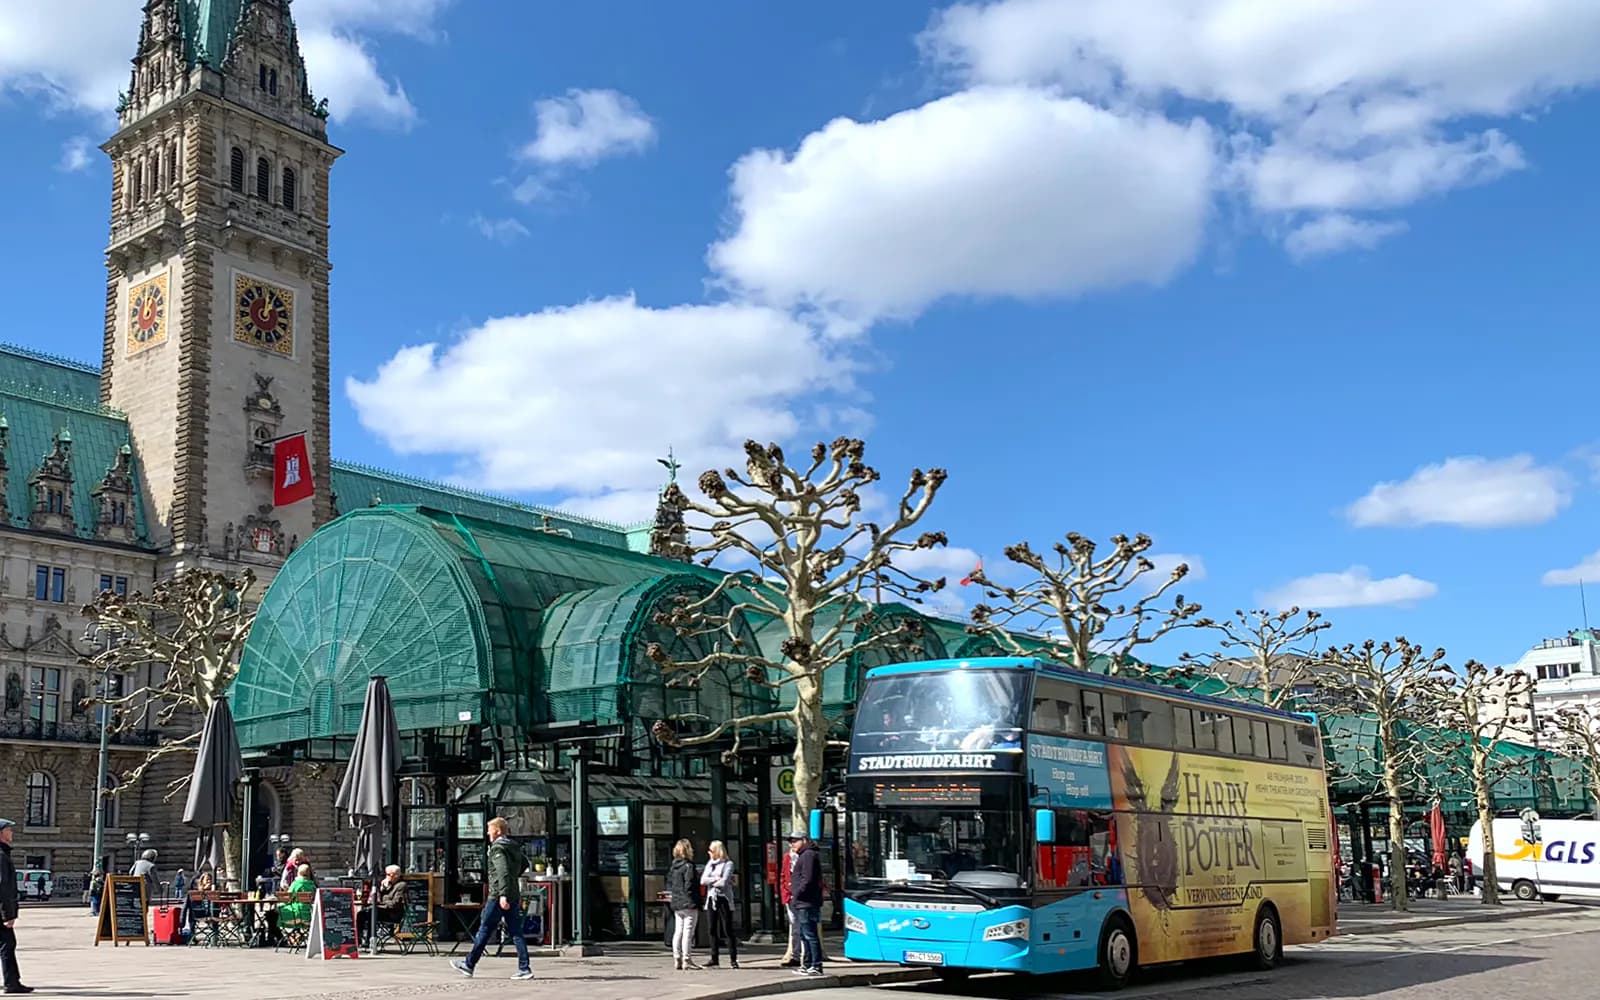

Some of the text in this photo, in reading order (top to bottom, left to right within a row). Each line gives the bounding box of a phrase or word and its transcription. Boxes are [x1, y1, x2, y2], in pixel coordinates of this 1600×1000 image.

[859, 754, 996, 770] STADTRUNDFAHRT
[1031, 744, 1103, 764] STADTRUNDFAHRT
[1183, 773, 1249, 826] HARRY
[1183, 821, 1260, 876] POTTER
[1545, 840, 1596, 864] GLS
[1186, 885, 1263, 904] VERWUNSCHENE KIND
